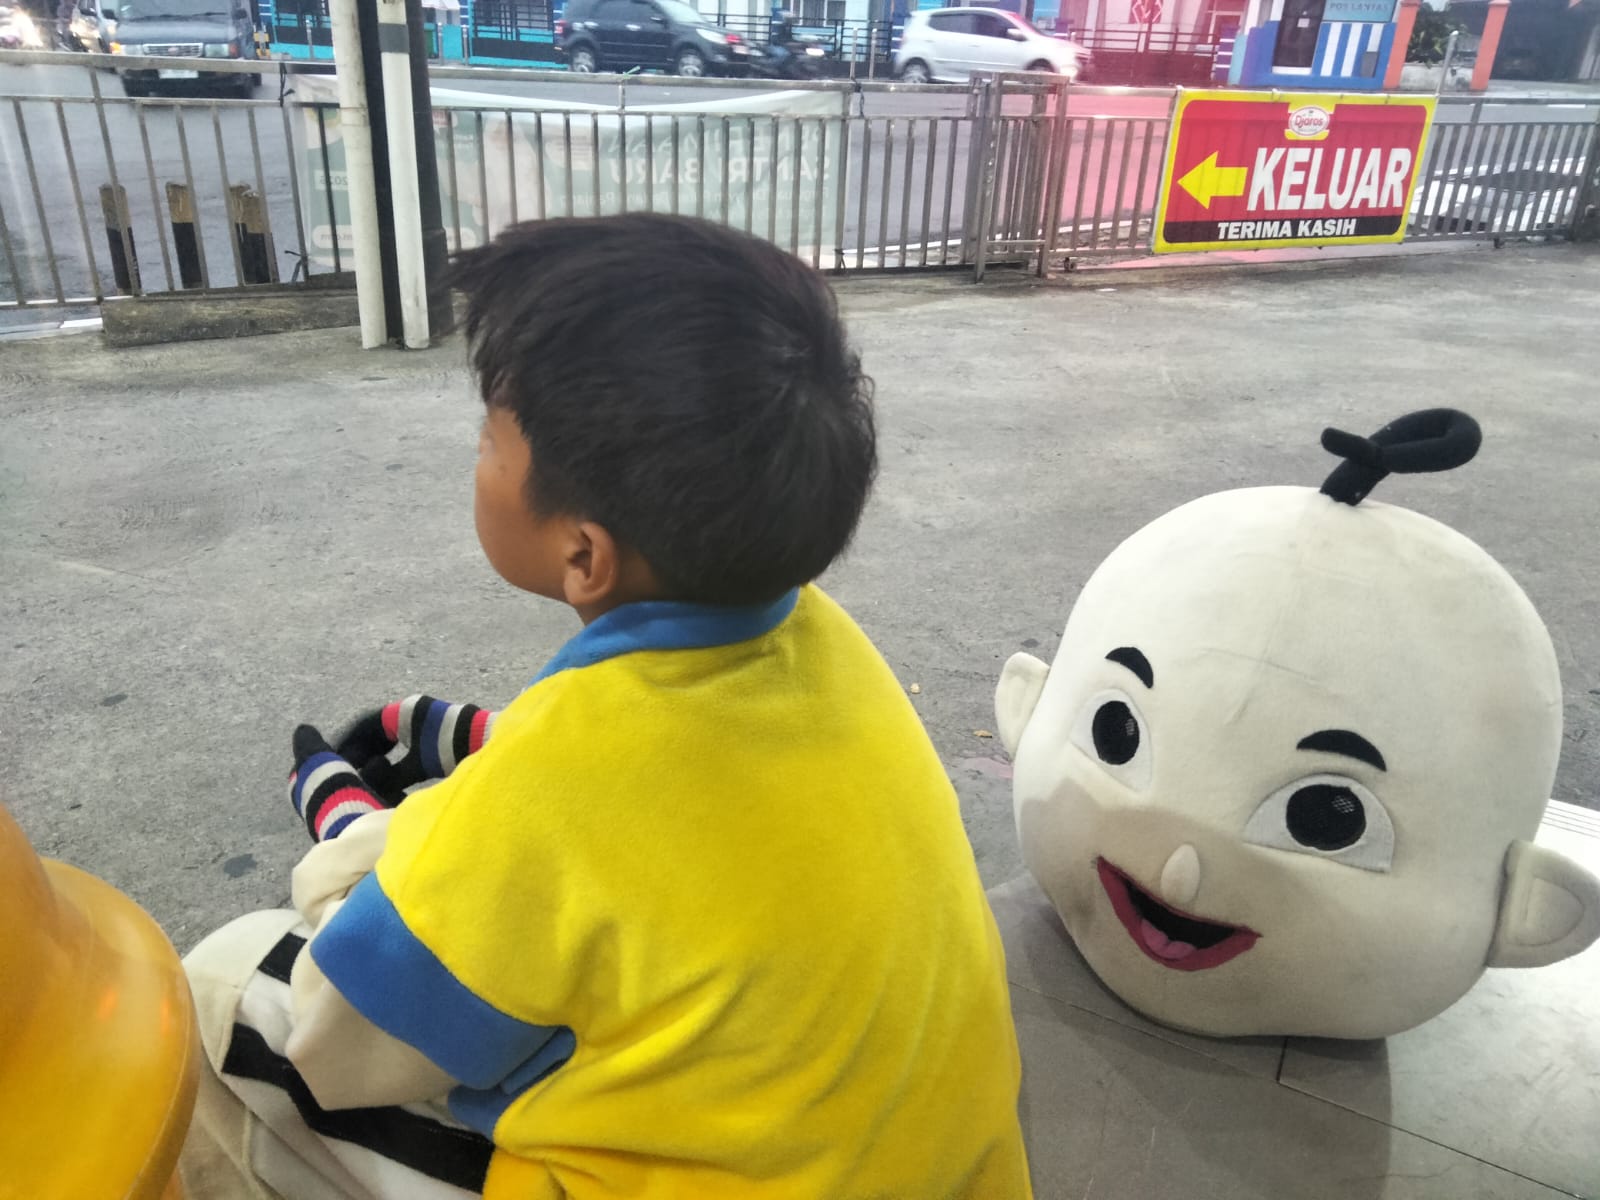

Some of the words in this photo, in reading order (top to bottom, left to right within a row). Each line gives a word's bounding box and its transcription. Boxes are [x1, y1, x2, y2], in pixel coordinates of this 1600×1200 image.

[1247, 147, 1412, 211] KELUAR
[1218, 220, 1292, 240] TERIMA
[1297, 218, 1357, 236] KASIH
